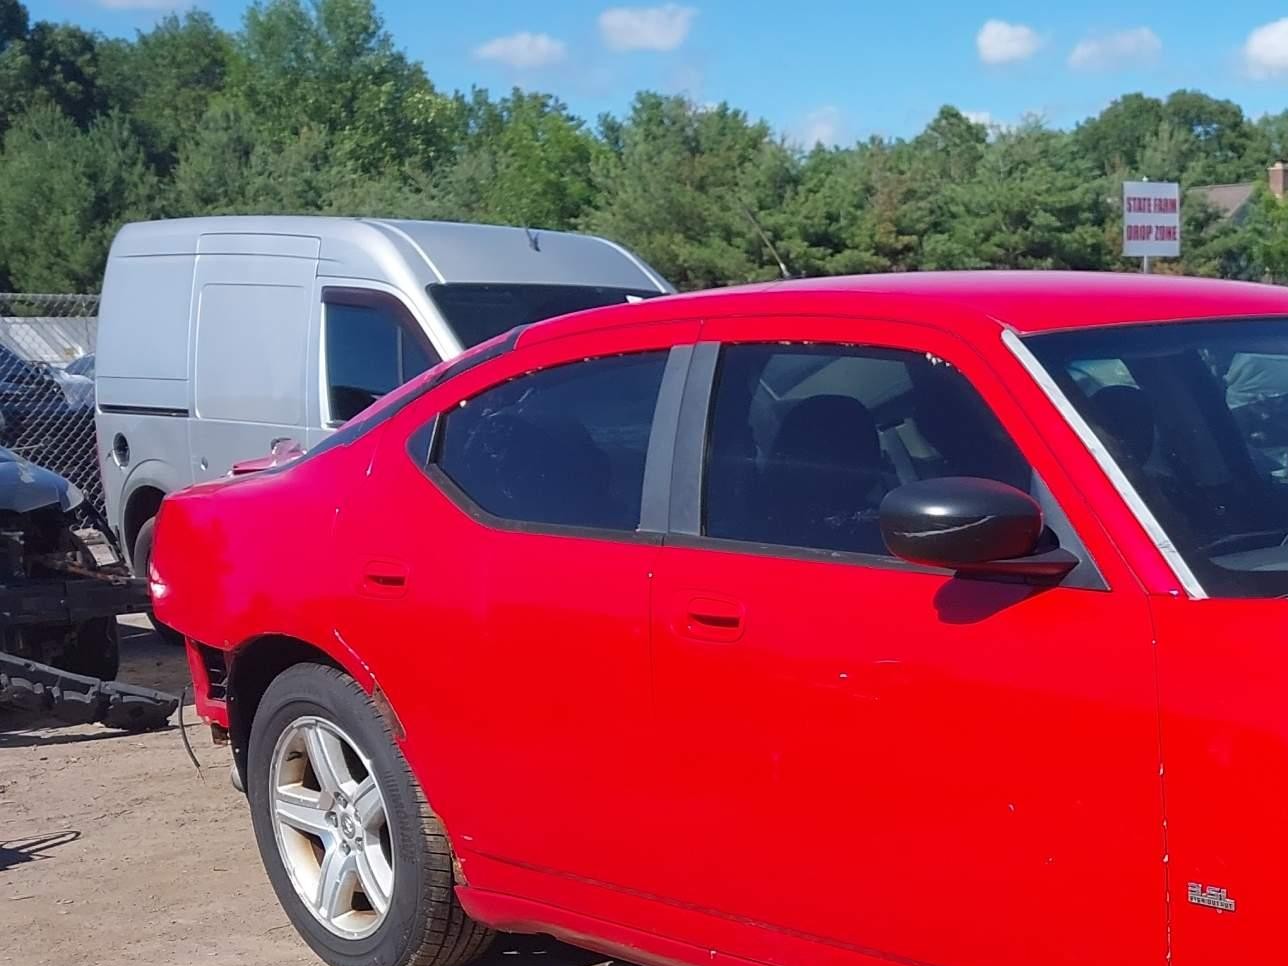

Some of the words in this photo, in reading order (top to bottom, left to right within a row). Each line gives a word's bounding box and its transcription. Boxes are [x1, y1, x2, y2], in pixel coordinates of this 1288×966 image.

[1126, 197, 1152, 213] STATE
[1154, 198, 1177, 213] FARM
[1126, 225, 1152, 240] DROP
[1155, 226, 1177, 240] ZONE
